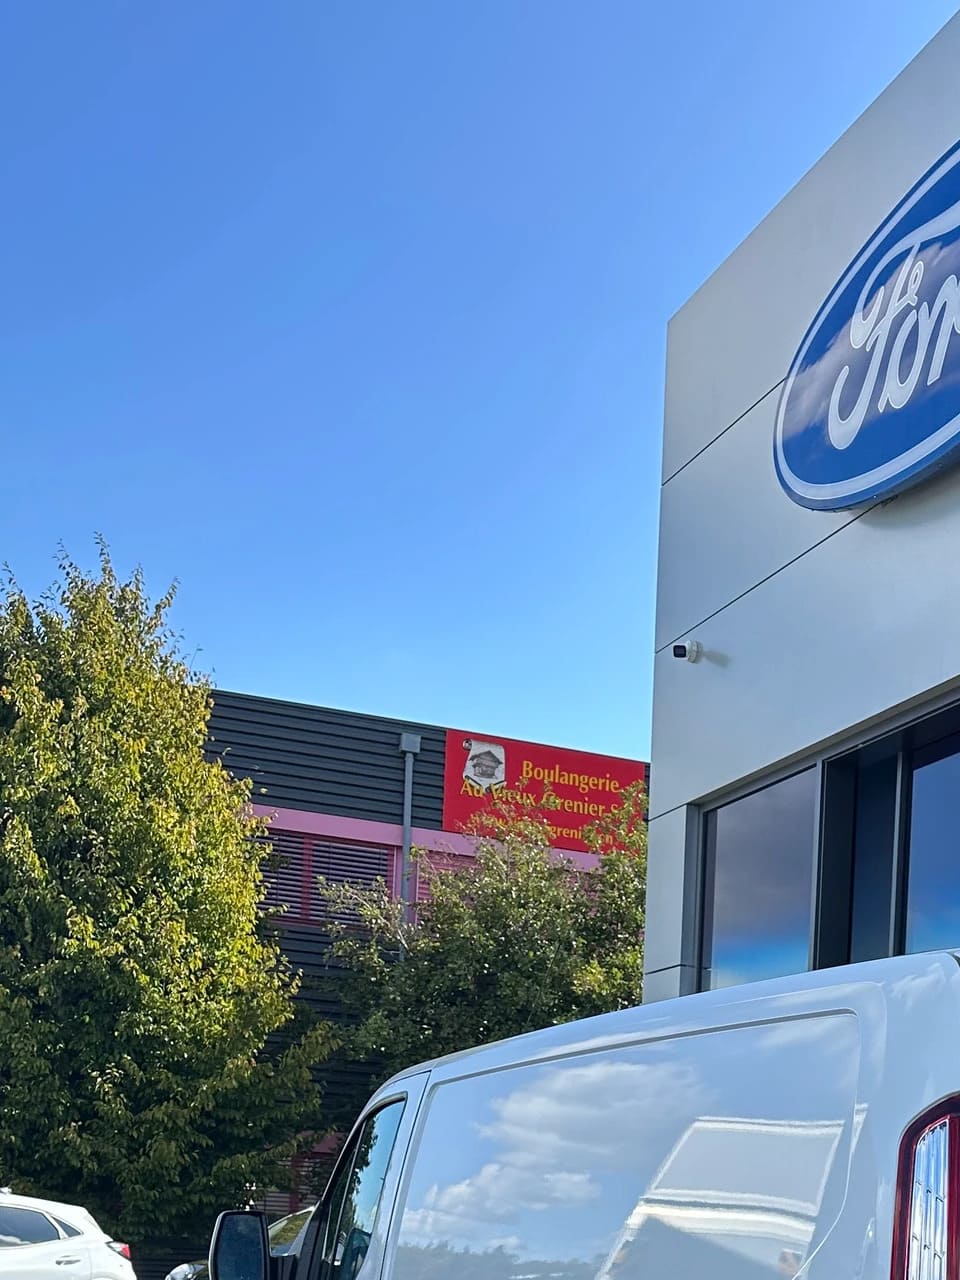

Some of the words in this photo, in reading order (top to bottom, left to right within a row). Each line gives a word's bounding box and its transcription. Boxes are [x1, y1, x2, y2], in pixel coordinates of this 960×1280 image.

[522, 760, 620, 794] Boulangerie
[460, 780, 485, 798] Au
[541, 791, 605, 817] Grenier
